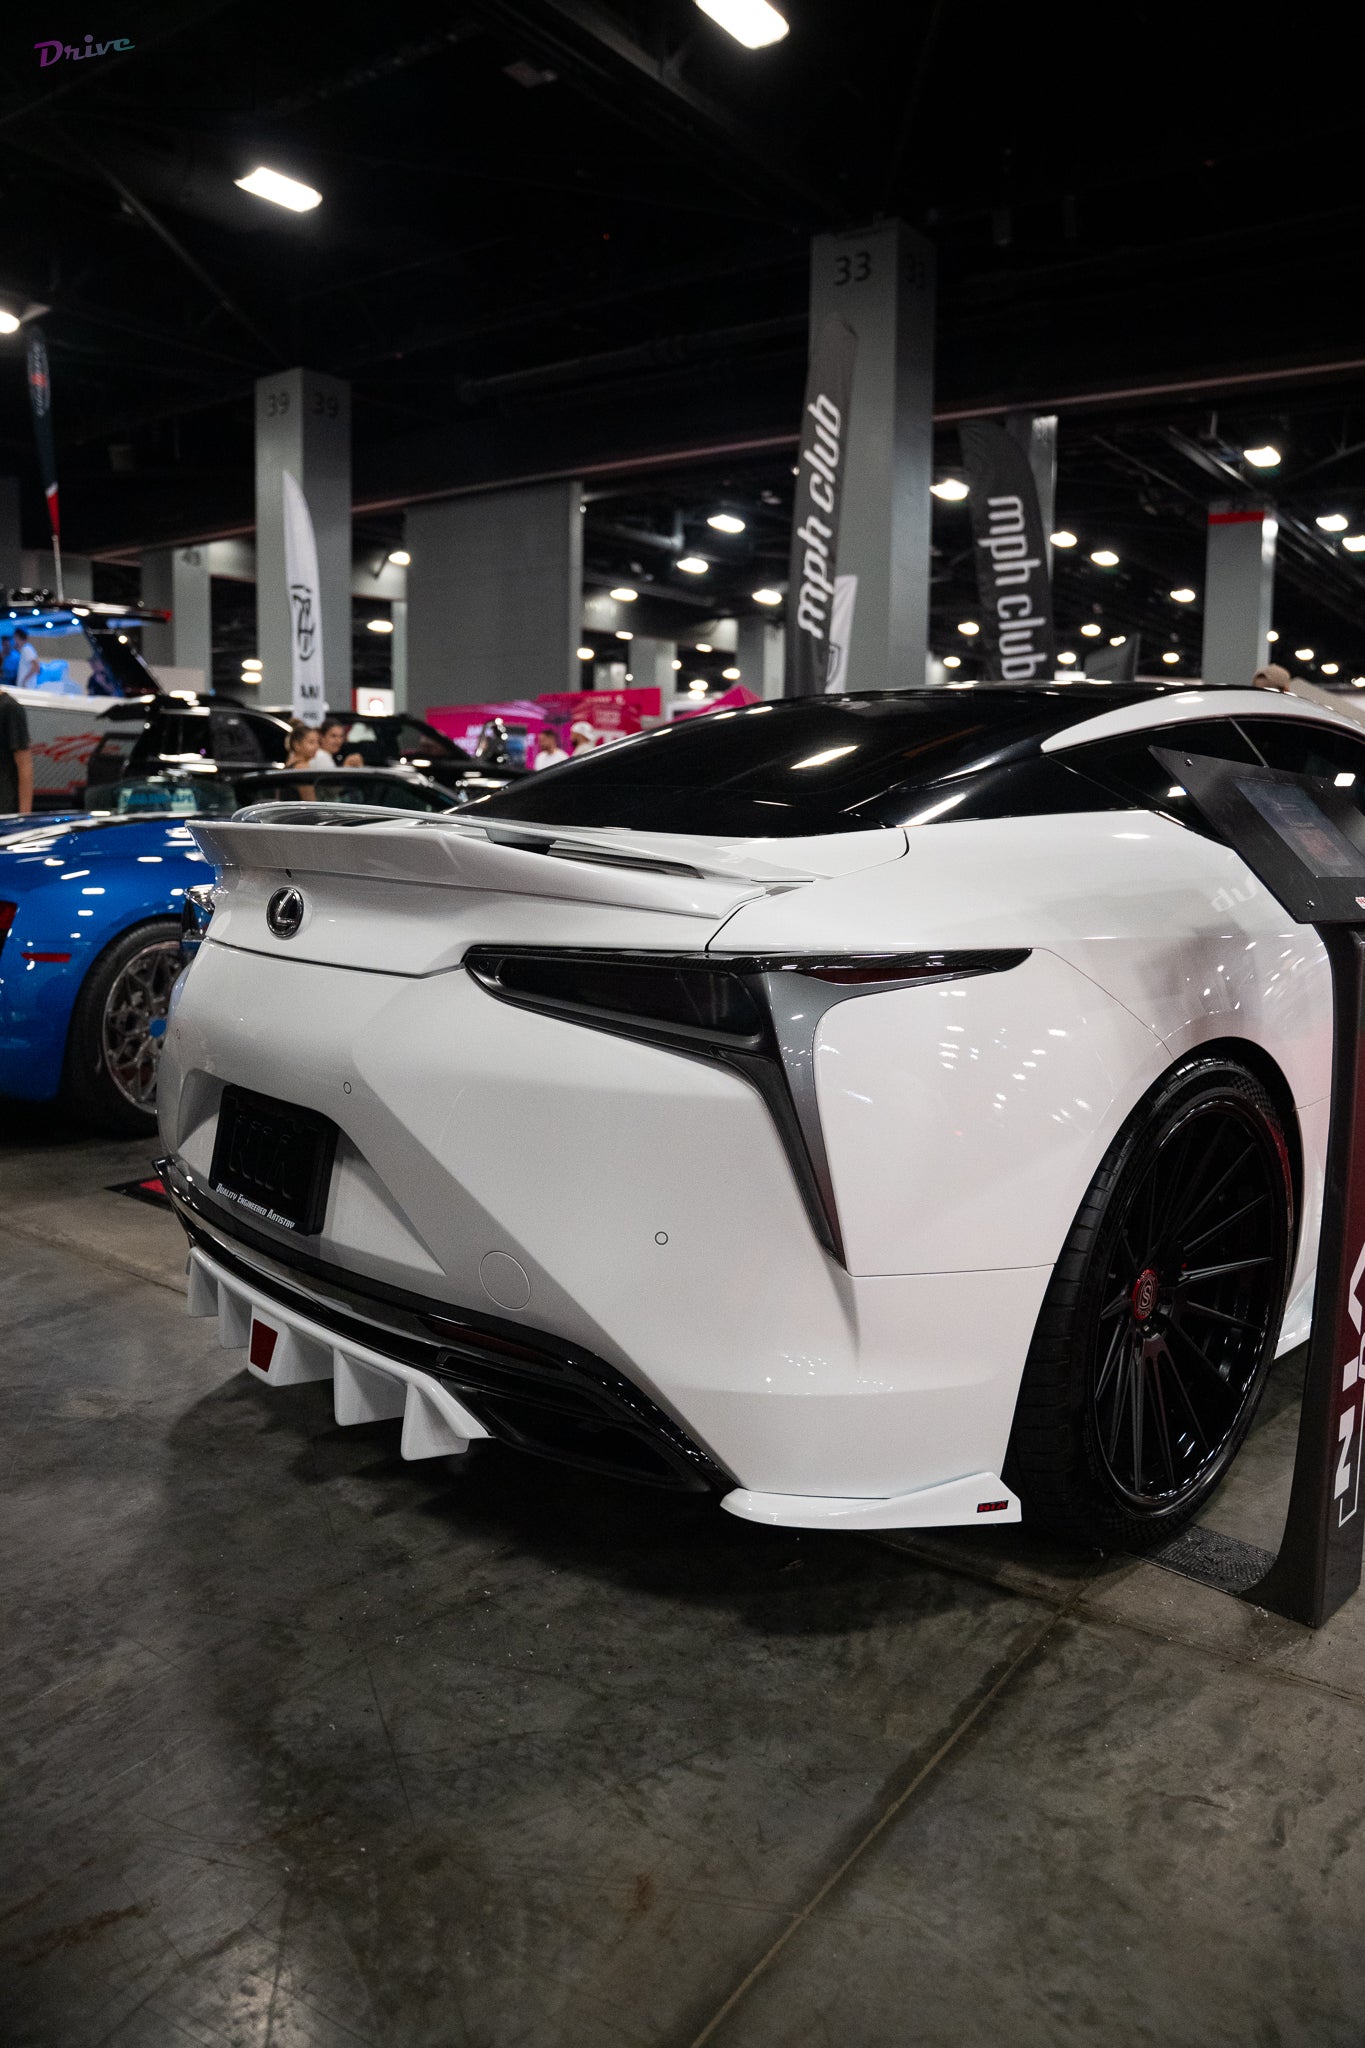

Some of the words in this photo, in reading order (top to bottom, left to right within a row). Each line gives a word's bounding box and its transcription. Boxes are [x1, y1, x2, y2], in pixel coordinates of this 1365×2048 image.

[834, 251, 871, 286] 33
[803, 394, 841, 514] club
[797, 515, 835, 640] mph
[977, 495, 1041, 586] mph
[997, 593, 1047, 680] club
